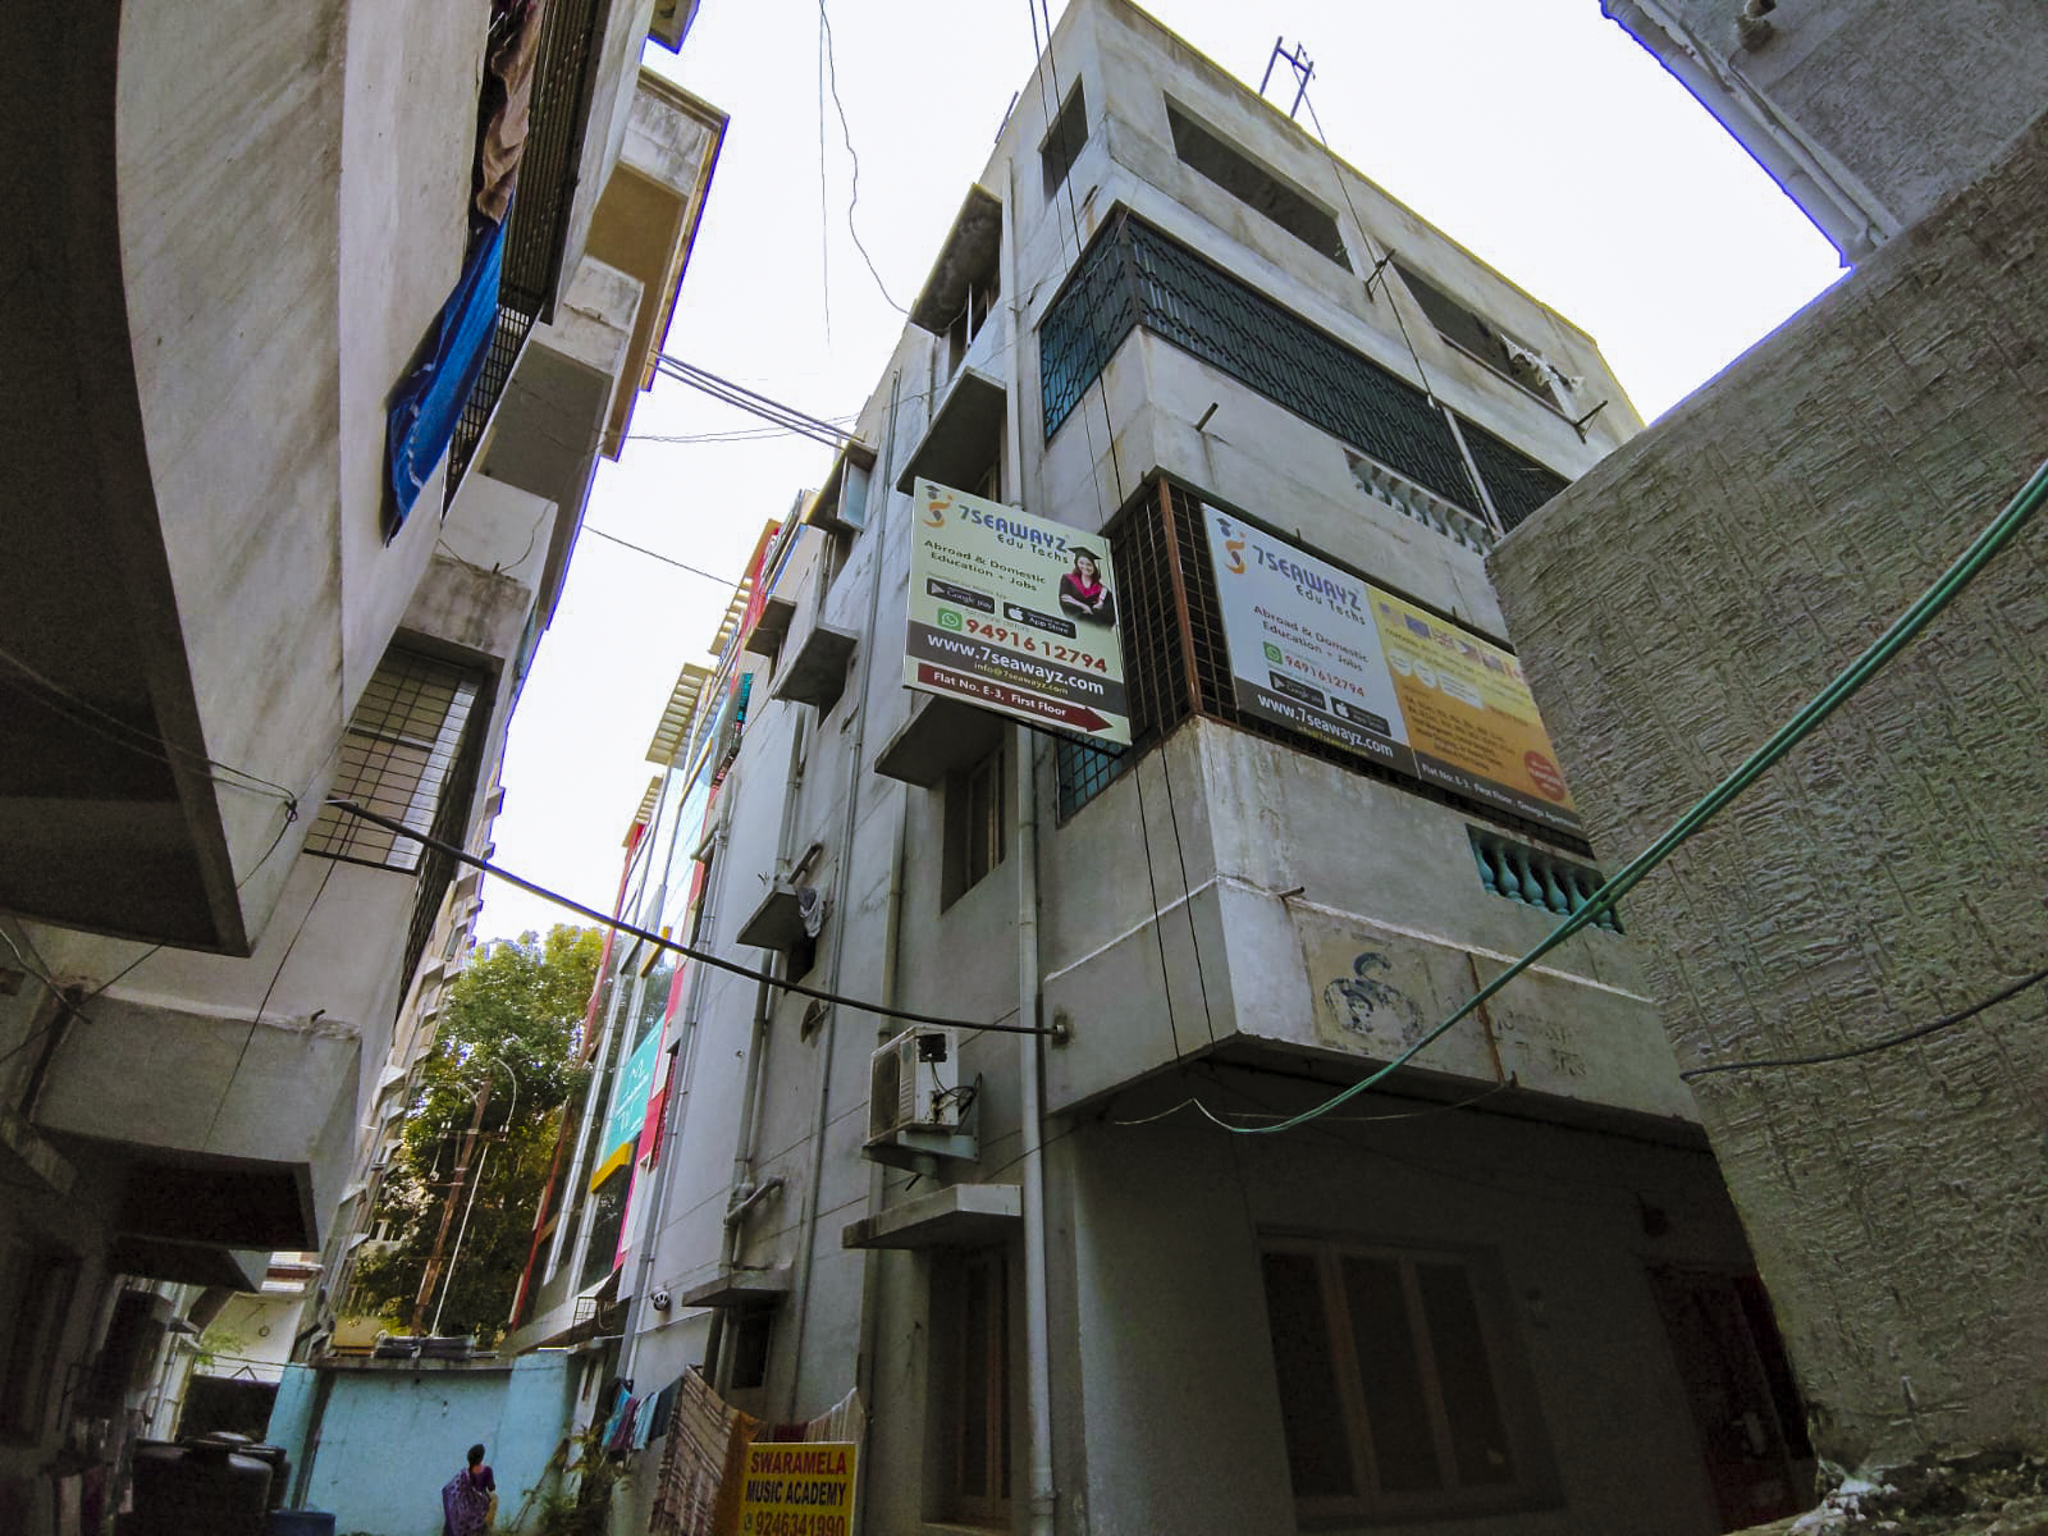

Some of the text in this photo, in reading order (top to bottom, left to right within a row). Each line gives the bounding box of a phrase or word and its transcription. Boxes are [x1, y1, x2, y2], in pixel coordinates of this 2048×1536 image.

[959, 504, 1067, 553] 7SEAWAYZ
[997, 533, 1069, 564] Edu Techs
[924, 540, 1045, 584] Abroad & Domestic
[931, 552, 993, 577] Education
[1010, 577, 1037, 591] Jobs
[1252, 545, 1361, 612] 7SEAWAYZ
[1296, 585, 1365, 625] Edu Techs
[1254, 605, 1298, 631] Abroad
[1315, 632, 1369, 663] Domestic
[1262, 620, 1322, 653] Education
[927, 634, 1104, 695] www.7seawayz.com
[974, 662, 1069, 695] info@7seawayz.com
[933, 671, 956, 686] Flat
[959, 678, 980, 692] No.
[1011, 693, 1036, 708] First
[1038, 700, 1066, 717] Floor
[1258, 693, 1393, 758] www.7seawayz.com
[750, 1451, 846, 1475] SWARAMELA
[746, 1480, 847, 1506] MUSIC ACADEMY
